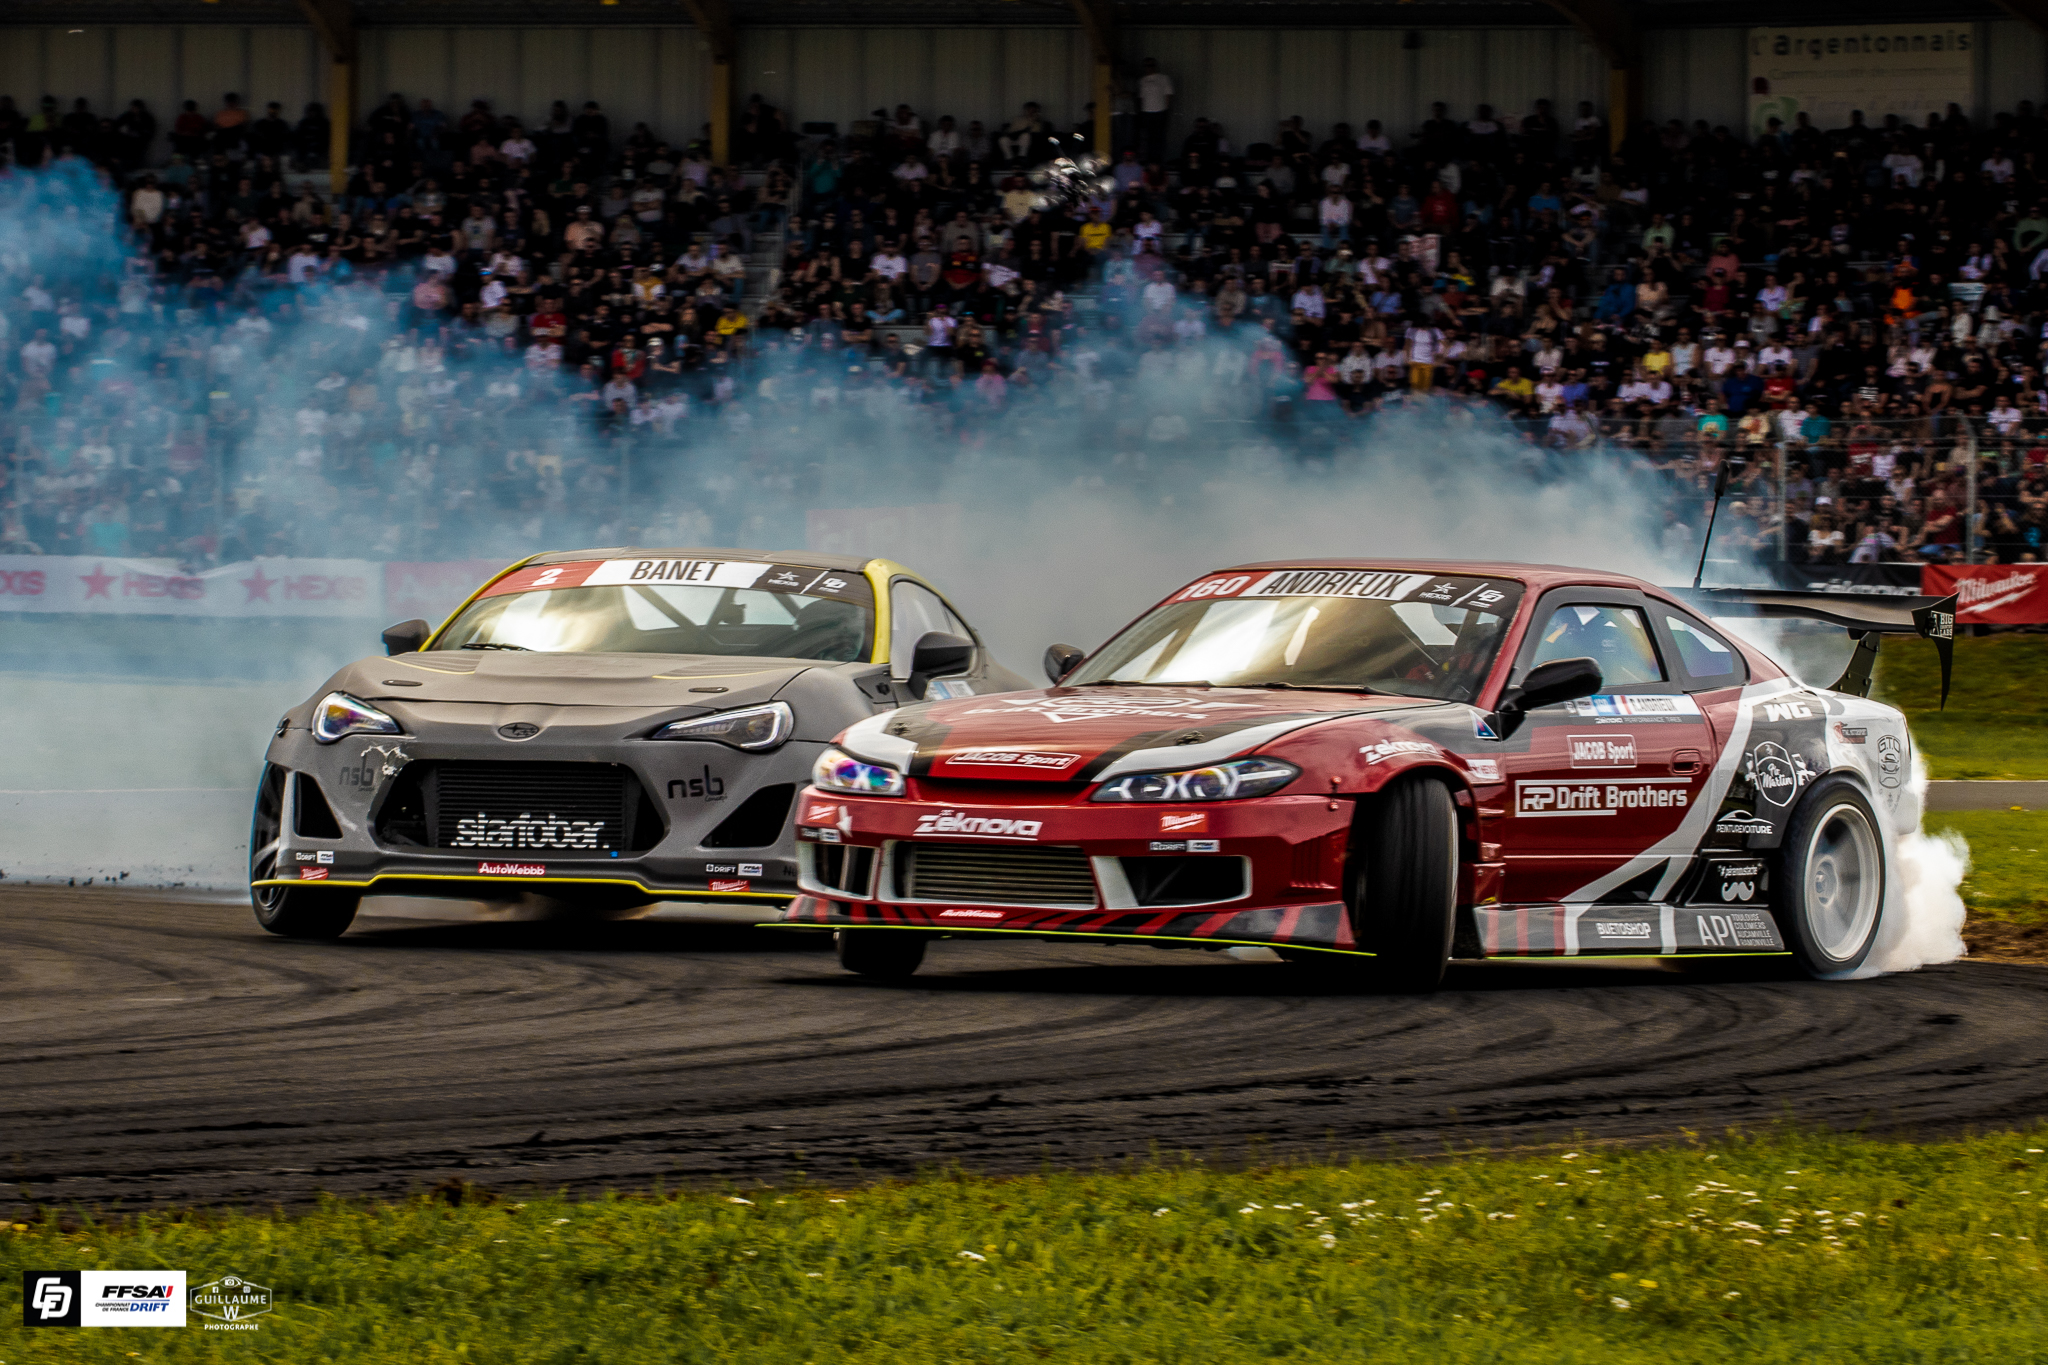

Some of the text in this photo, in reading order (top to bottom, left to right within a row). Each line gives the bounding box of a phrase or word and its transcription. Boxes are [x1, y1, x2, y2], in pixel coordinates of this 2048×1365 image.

[533, 568, 564, 586] 2
[629, 561, 726, 581] BANET
[1175, 576, 1222, 601] 160
[1258, 571, 1411, 598] ANDRIEUX
[1940, 613, 1953, 625] BIG
[1763, 702, 1813, 723] WG
[954, 752, 1071, 766] JACOB Sport
[1572, 741, 1635, 765] JACOB Sport
[667, 764, 725, 799] nsb
[1556, 786, 1602, 810] Drift
[1605, 785, 1688, 809] Brothers
[1731, 913, 1761, 921] TOULOUSE
[1697, 914, 1741, 946] API
